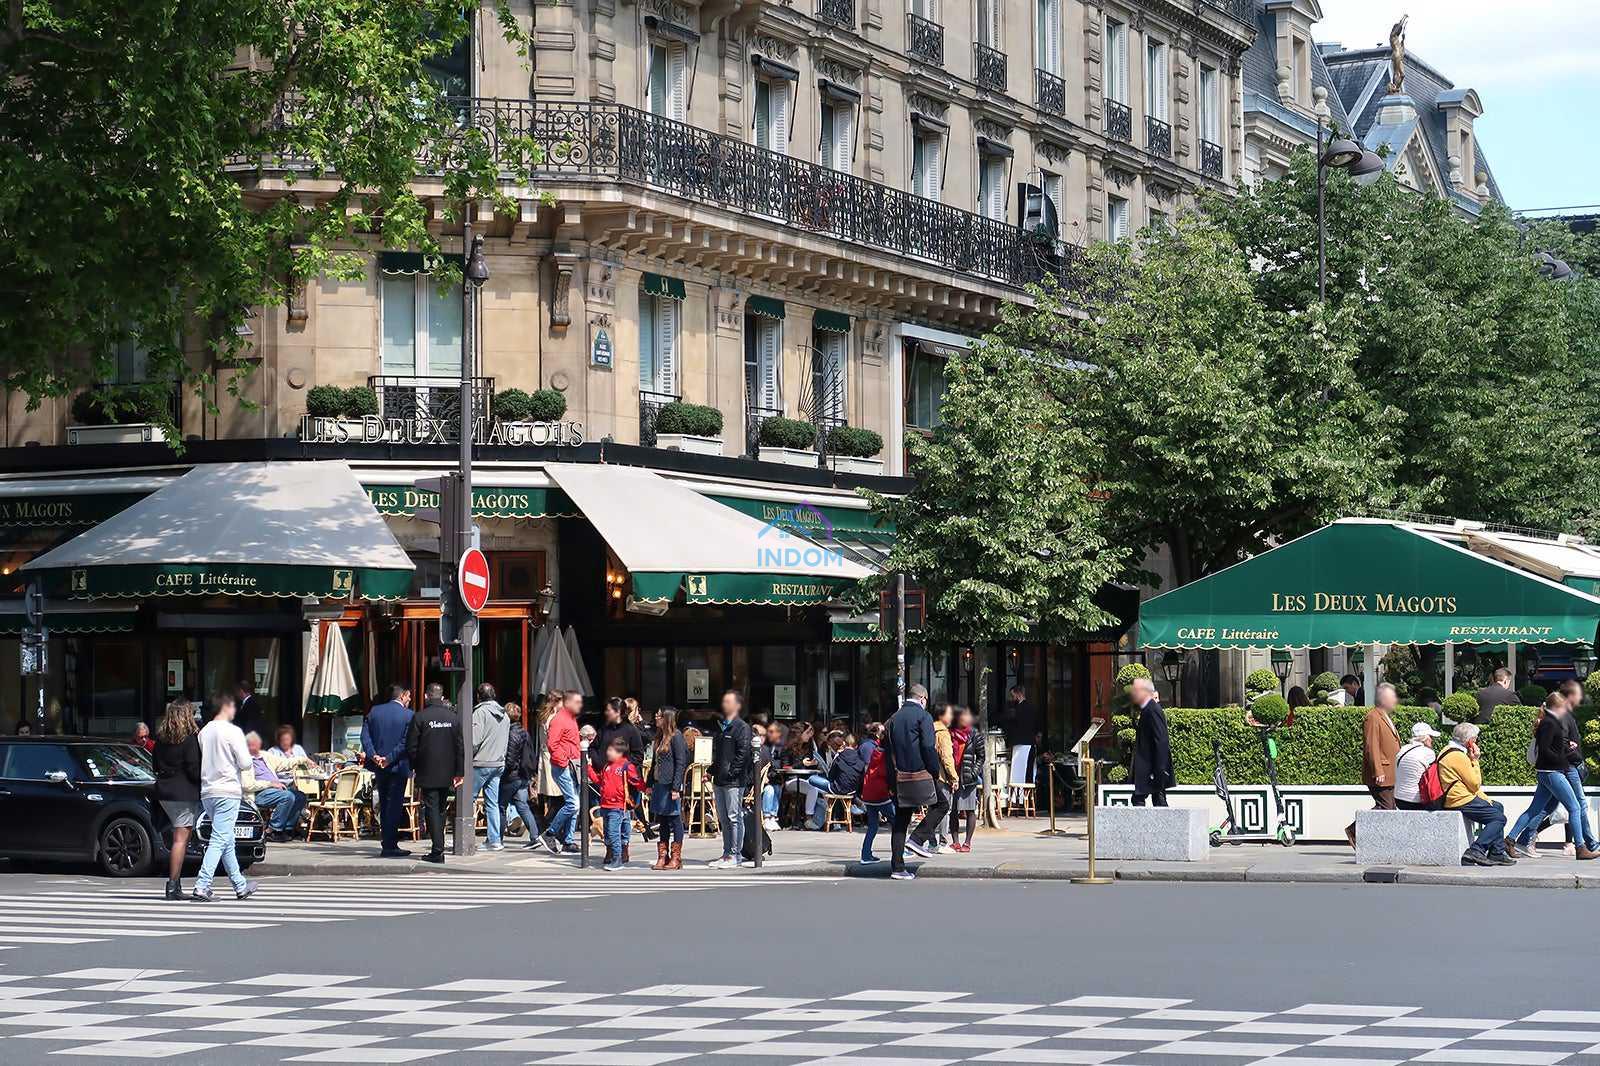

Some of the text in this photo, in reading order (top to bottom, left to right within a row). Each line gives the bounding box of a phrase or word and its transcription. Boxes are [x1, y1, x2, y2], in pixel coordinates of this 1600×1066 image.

[300, 413, 349, 443] LES
[360, 414, 449, 445] DEUX
[367, 490, 397, 507] LES
[405, 491, 440, 508] DEU
[15, 502, 73, 519] MAGOTS
[156, 573, 257, 586] CAFE Littéraire
[1272, 593, 1457, 613] LES DEUX MAGOTS
[1177, 628, 1279, 640] CAFE Littéraire
[1449, 626, 1553, 635] RESTAURANT
